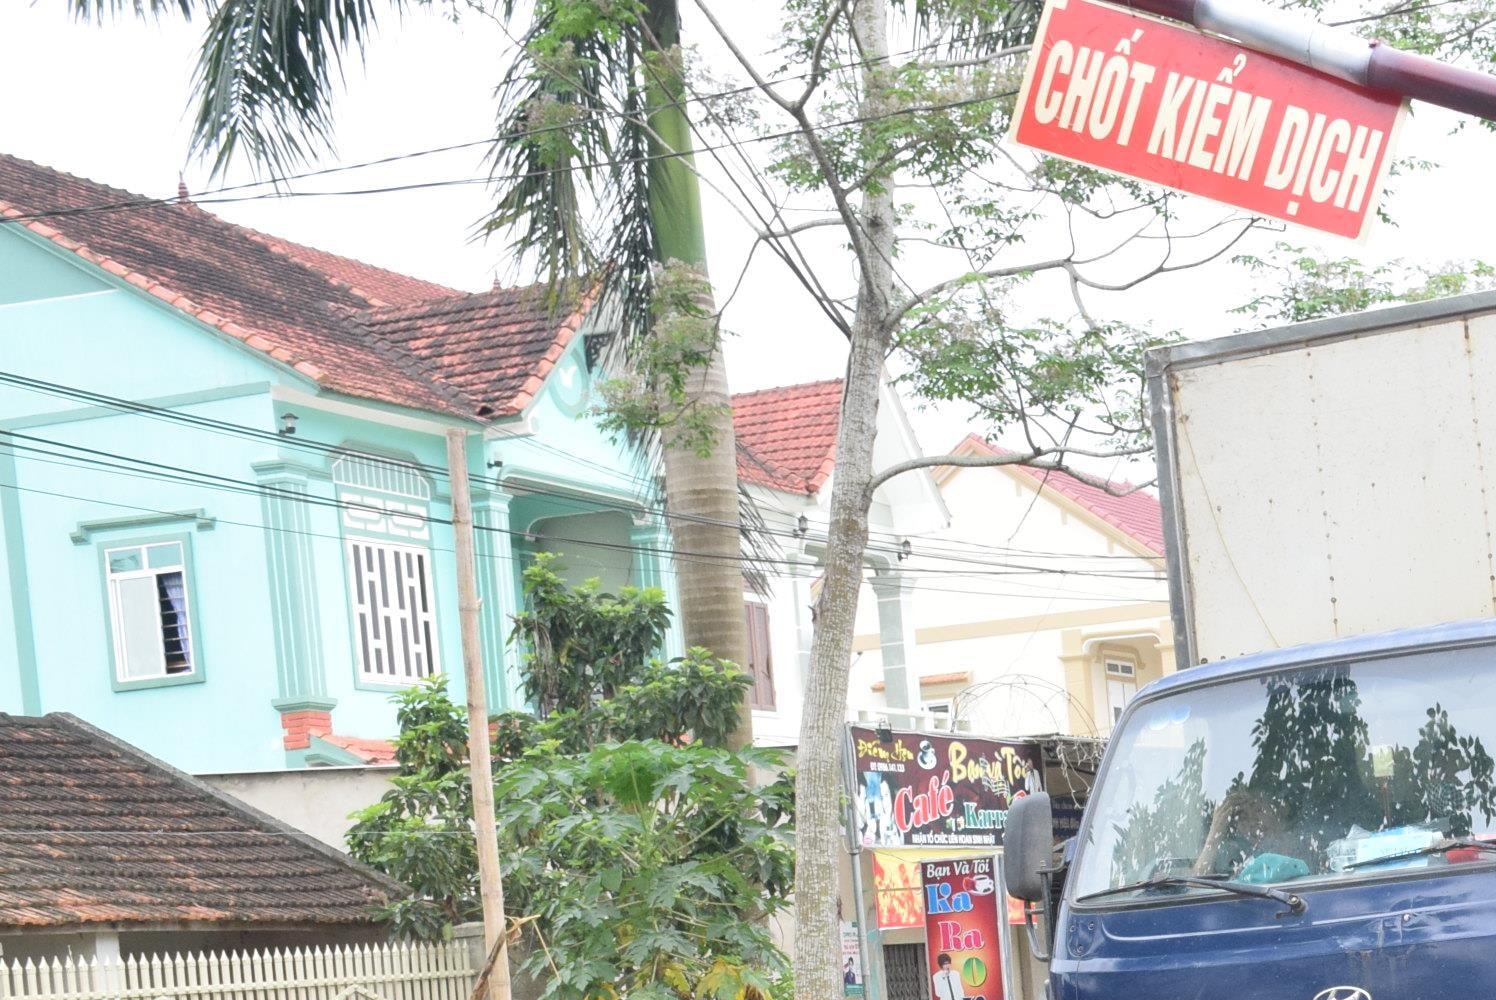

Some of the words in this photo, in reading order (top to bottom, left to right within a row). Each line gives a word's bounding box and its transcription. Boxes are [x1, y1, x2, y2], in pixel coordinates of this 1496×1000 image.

[1034, 29, 1155, 146] CHỐT
[1146, 53, 1272, 182] KIỂM
[1264, 104, 1384, 216] DỊCH
[894, 770, 954, 833] Café
[926, 863, 951, 880] Bạn
[953, 861, 970, 876] Và
[972, 859, 990, 874] Tôi
[925, 882, 974, 915] Ka
[938, 921, 985, 952] Ra
